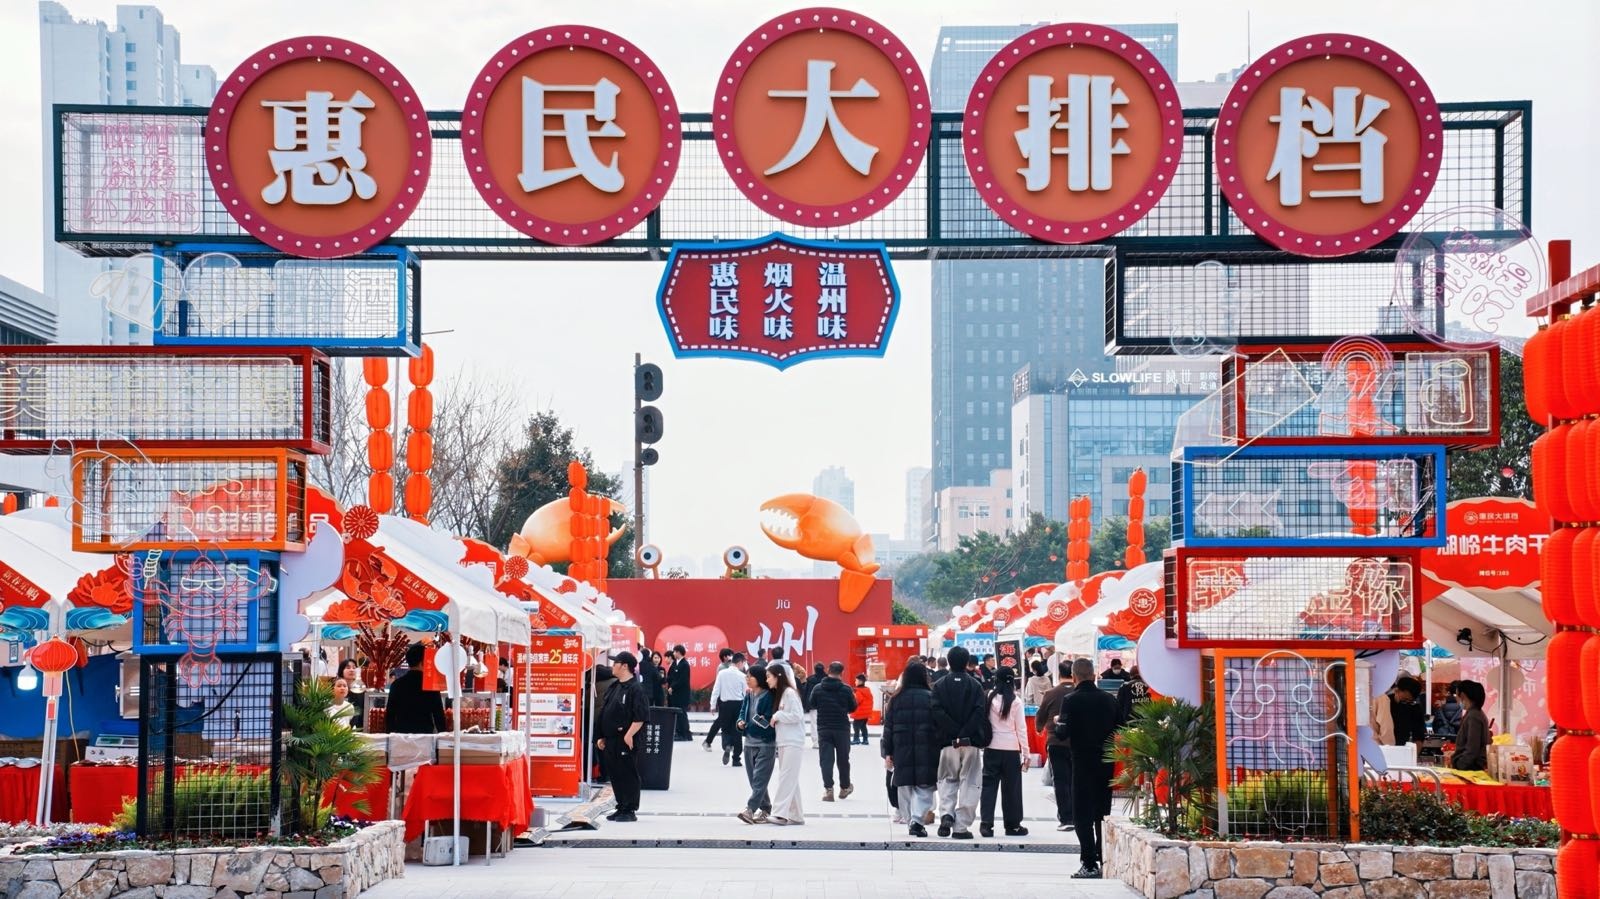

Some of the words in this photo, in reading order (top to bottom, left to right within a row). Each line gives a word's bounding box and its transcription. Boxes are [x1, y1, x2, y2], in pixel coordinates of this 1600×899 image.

[259, 59, 1392, 207] 惠民大排档
[83, 190, 197, 226] 小龙虾
[708, 261, 740, 341] 惠民味
[763, 261, 794, 341] 烟火味
[817, 261, 848, 341] 温州味
[1091, 372, 1162, 384] SLOWLIFE
[174, 465, 272, 496] JUST
[1437, 534, 1550, 556] 湖岭牛肉干
